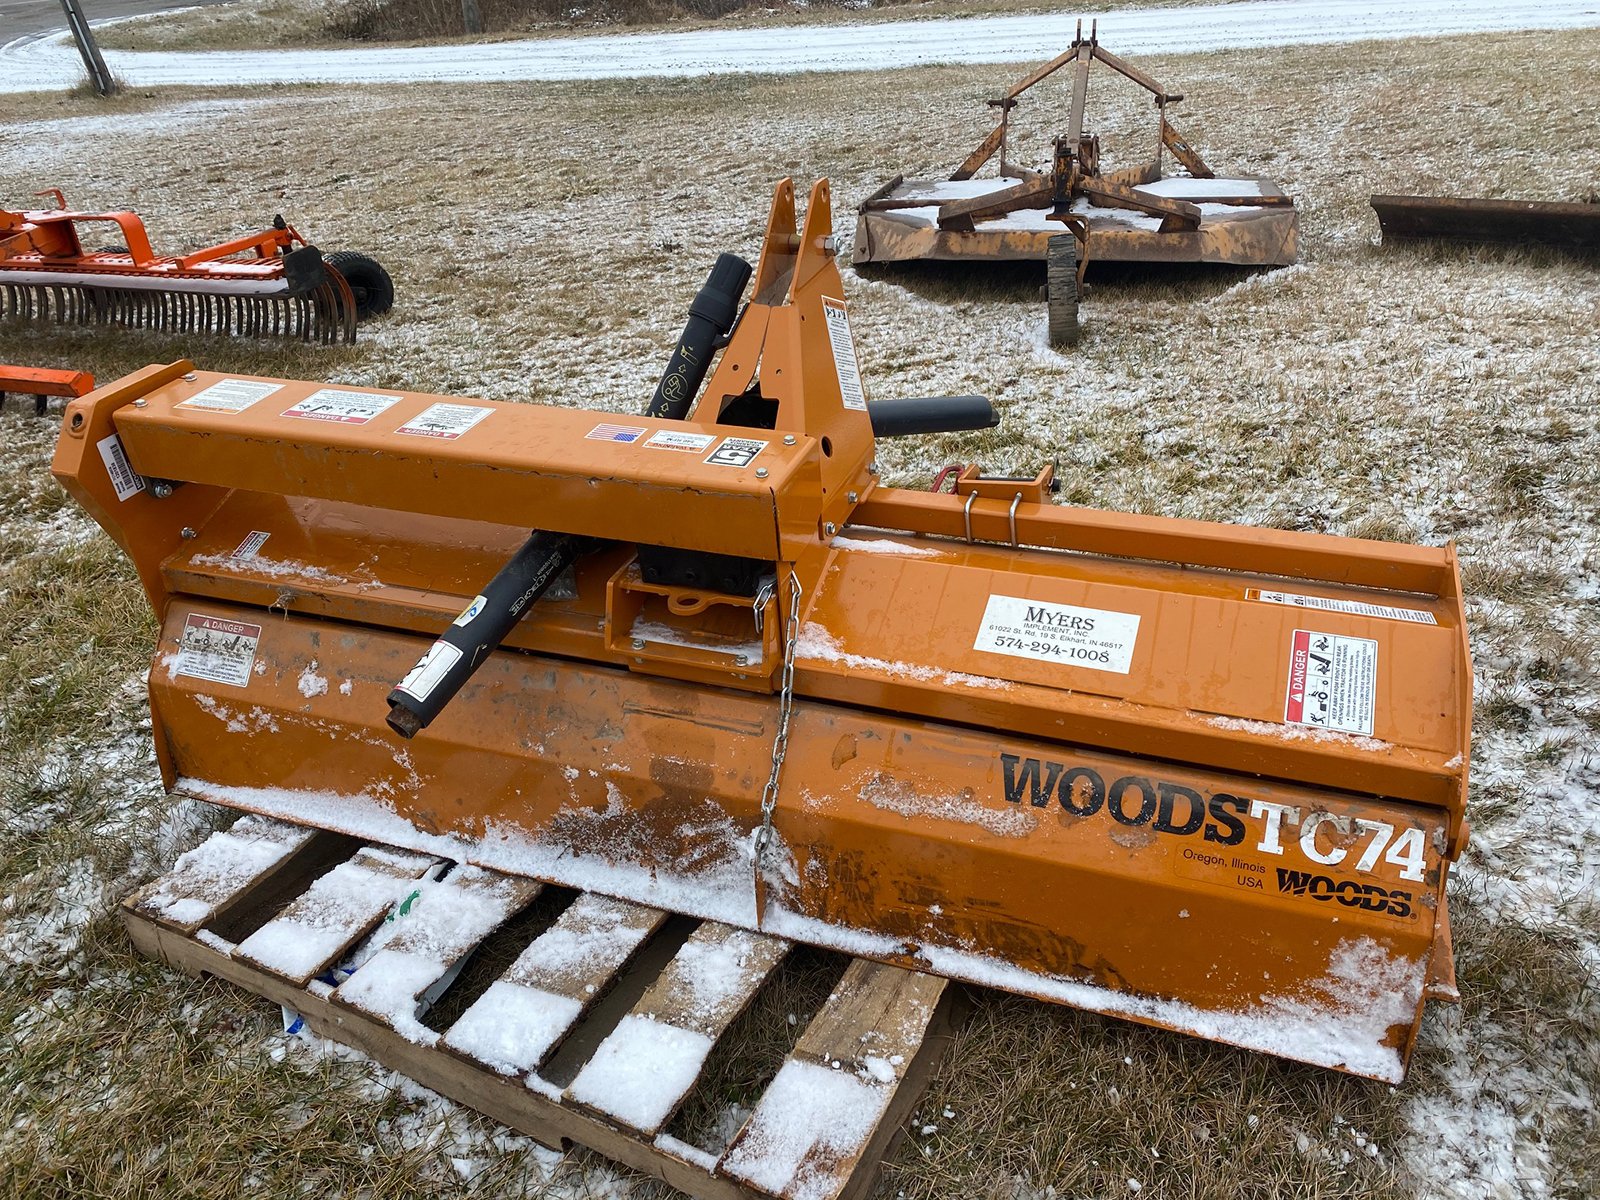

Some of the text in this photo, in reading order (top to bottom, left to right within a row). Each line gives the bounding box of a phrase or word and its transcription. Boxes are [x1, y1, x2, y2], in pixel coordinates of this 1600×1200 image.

[722, 445, 758, 453] YEAR
[211, 621, 244, 635] DANGER
[1024, 606, 1095, 631] MYERS
[1013, 627, 1022, 635] St.
[1040, 631, 1048, 639] 19
[1074, 629, 1090, 638] INC.
[994, 635, 1110, 663] 574-294-1008
[1293, 650, 1306, 690] DANGER
[1000, 752, 1428, 884] WOODS TC74
[1183, 848, 1266, 874] Oregon, Illinois
[1237, 875, 1264, 890] USA
[1275, 867, 1413, 920] WOODS
